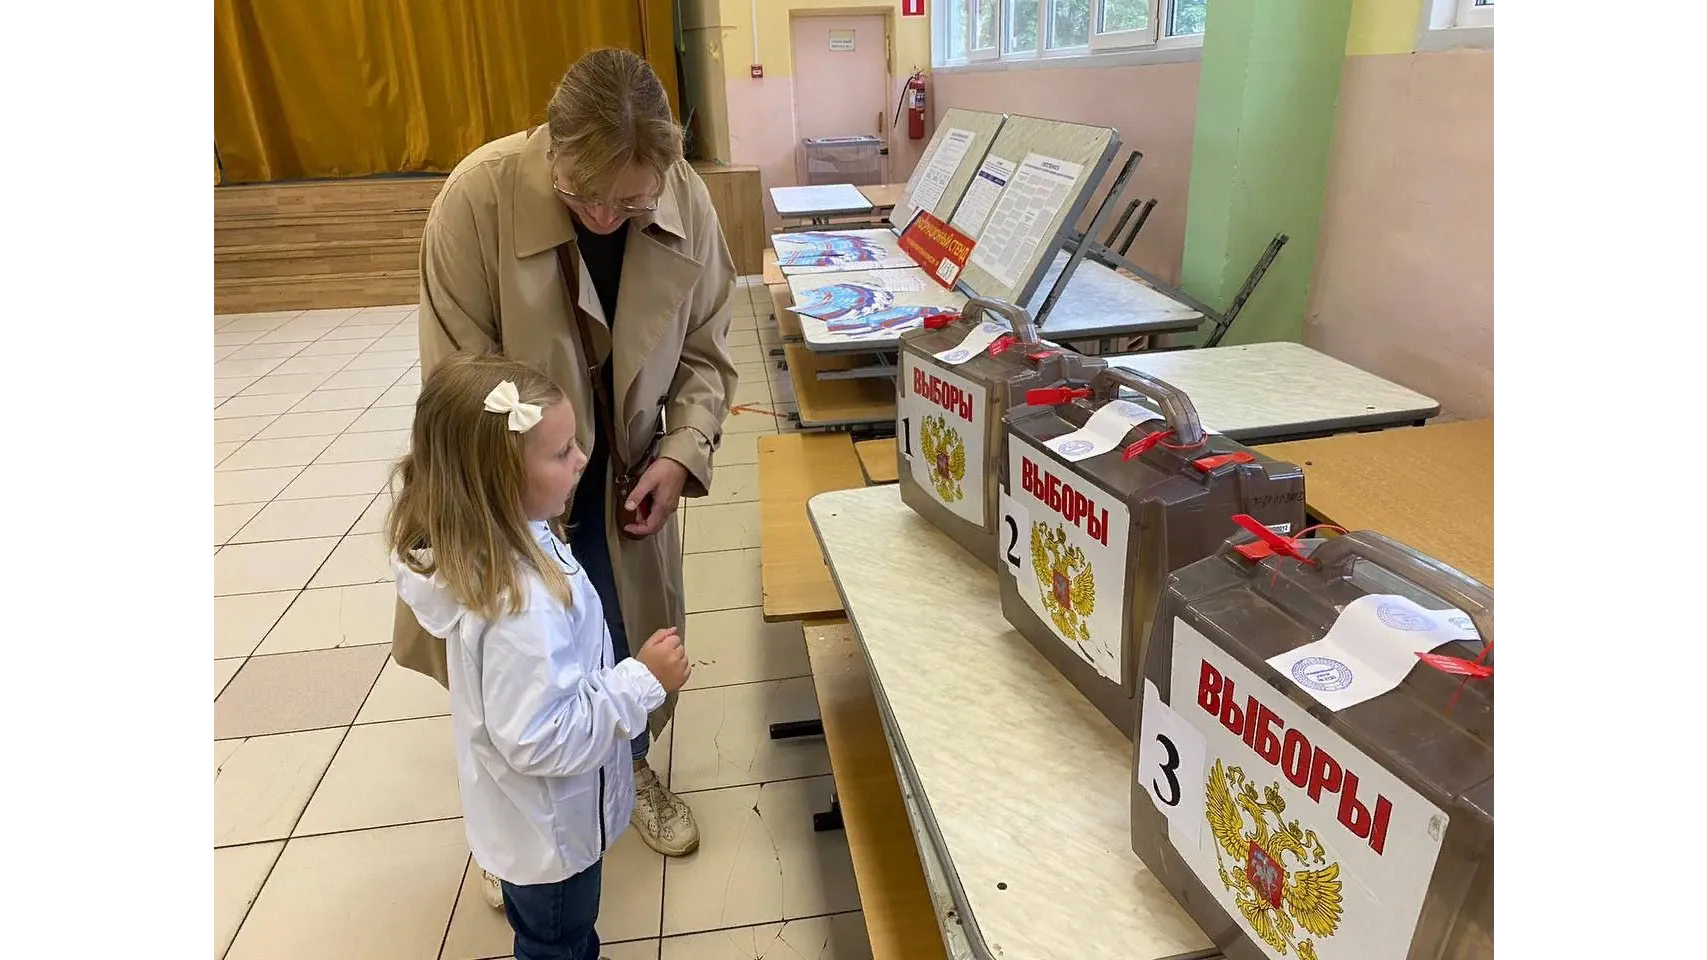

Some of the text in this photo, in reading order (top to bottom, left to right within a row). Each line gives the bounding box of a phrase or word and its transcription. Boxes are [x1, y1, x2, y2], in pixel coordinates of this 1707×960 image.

[913, 366, 973, 423] ВЫБОРЫ
[902, 417, 914, 457] 1
[1022, 456, 1109, 547] ВЫБОРЫ
[1005, 514, 1021, 568] 2
[1153, 734, 1181, 807] 3
[1198, 658, 1392, 856] ВЫБОРЫ
